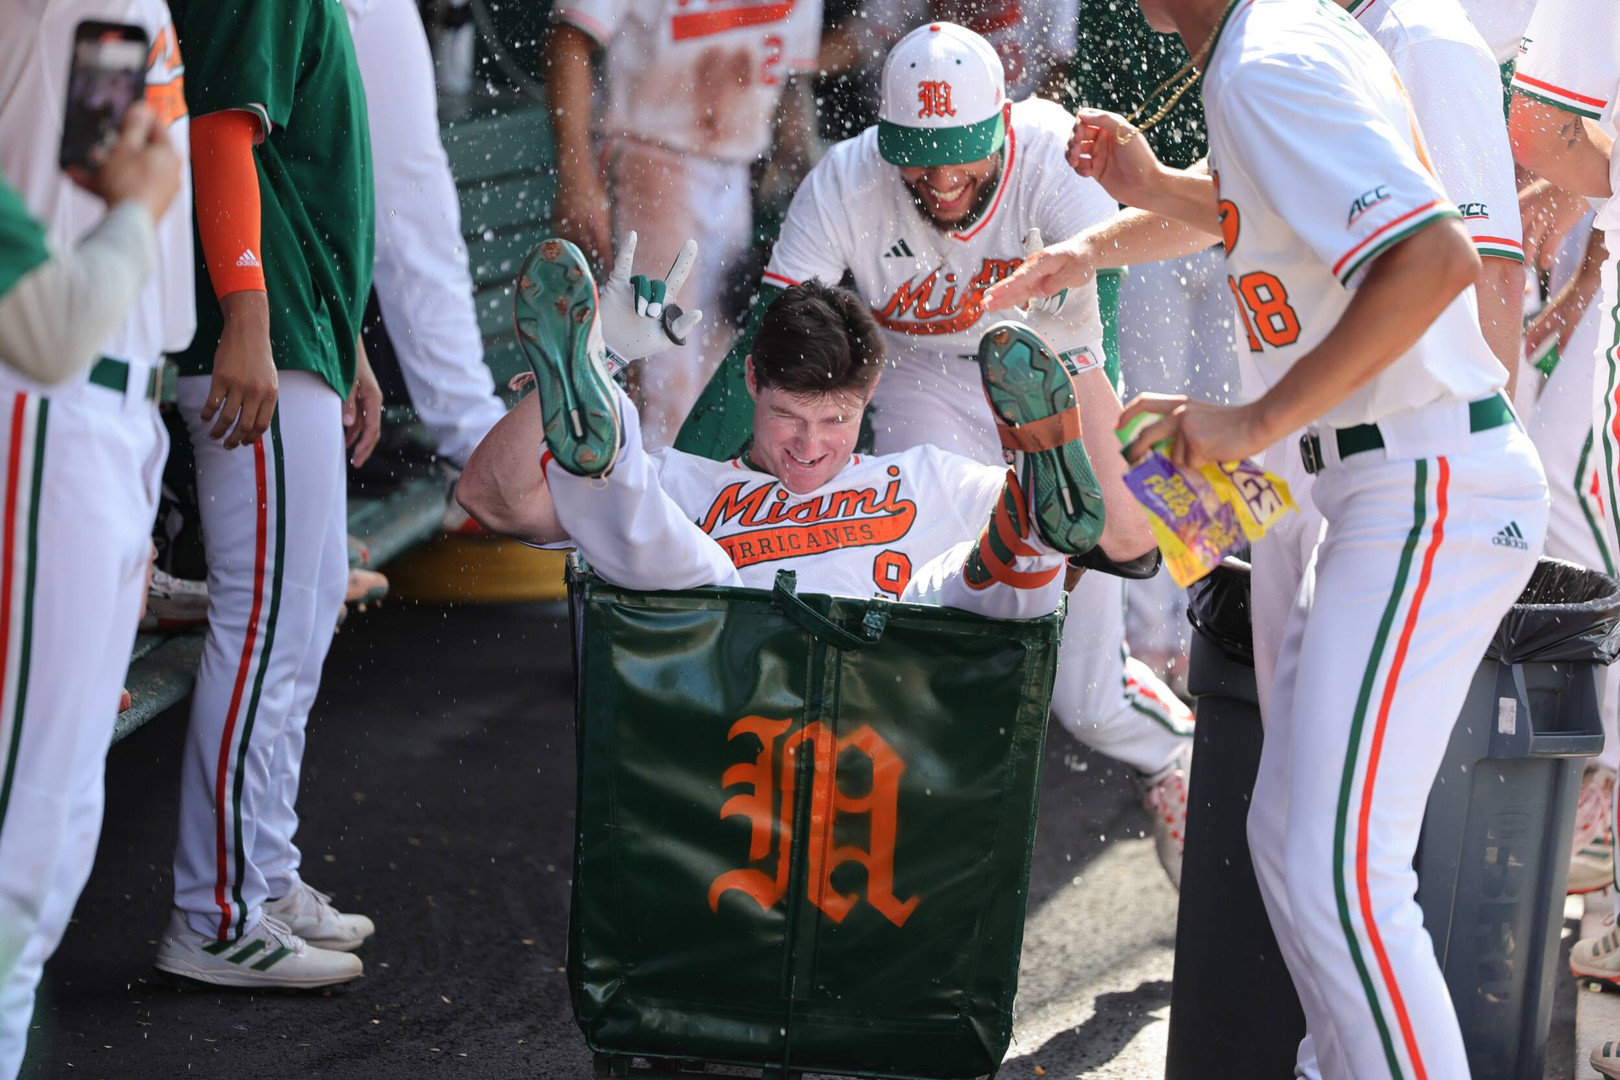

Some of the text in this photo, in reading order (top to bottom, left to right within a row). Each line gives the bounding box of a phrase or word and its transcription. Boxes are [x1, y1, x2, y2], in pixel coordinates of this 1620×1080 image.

[1347, 184, 1391, 226] ACC
[1227, 271, 1301, 352] 18
[694, 464, 908, 535] Miami
[728, 523, 874, 561] RRICANES
[1491, 536, 1529, 550] adidas
[873, 549, 912, 601] 9
